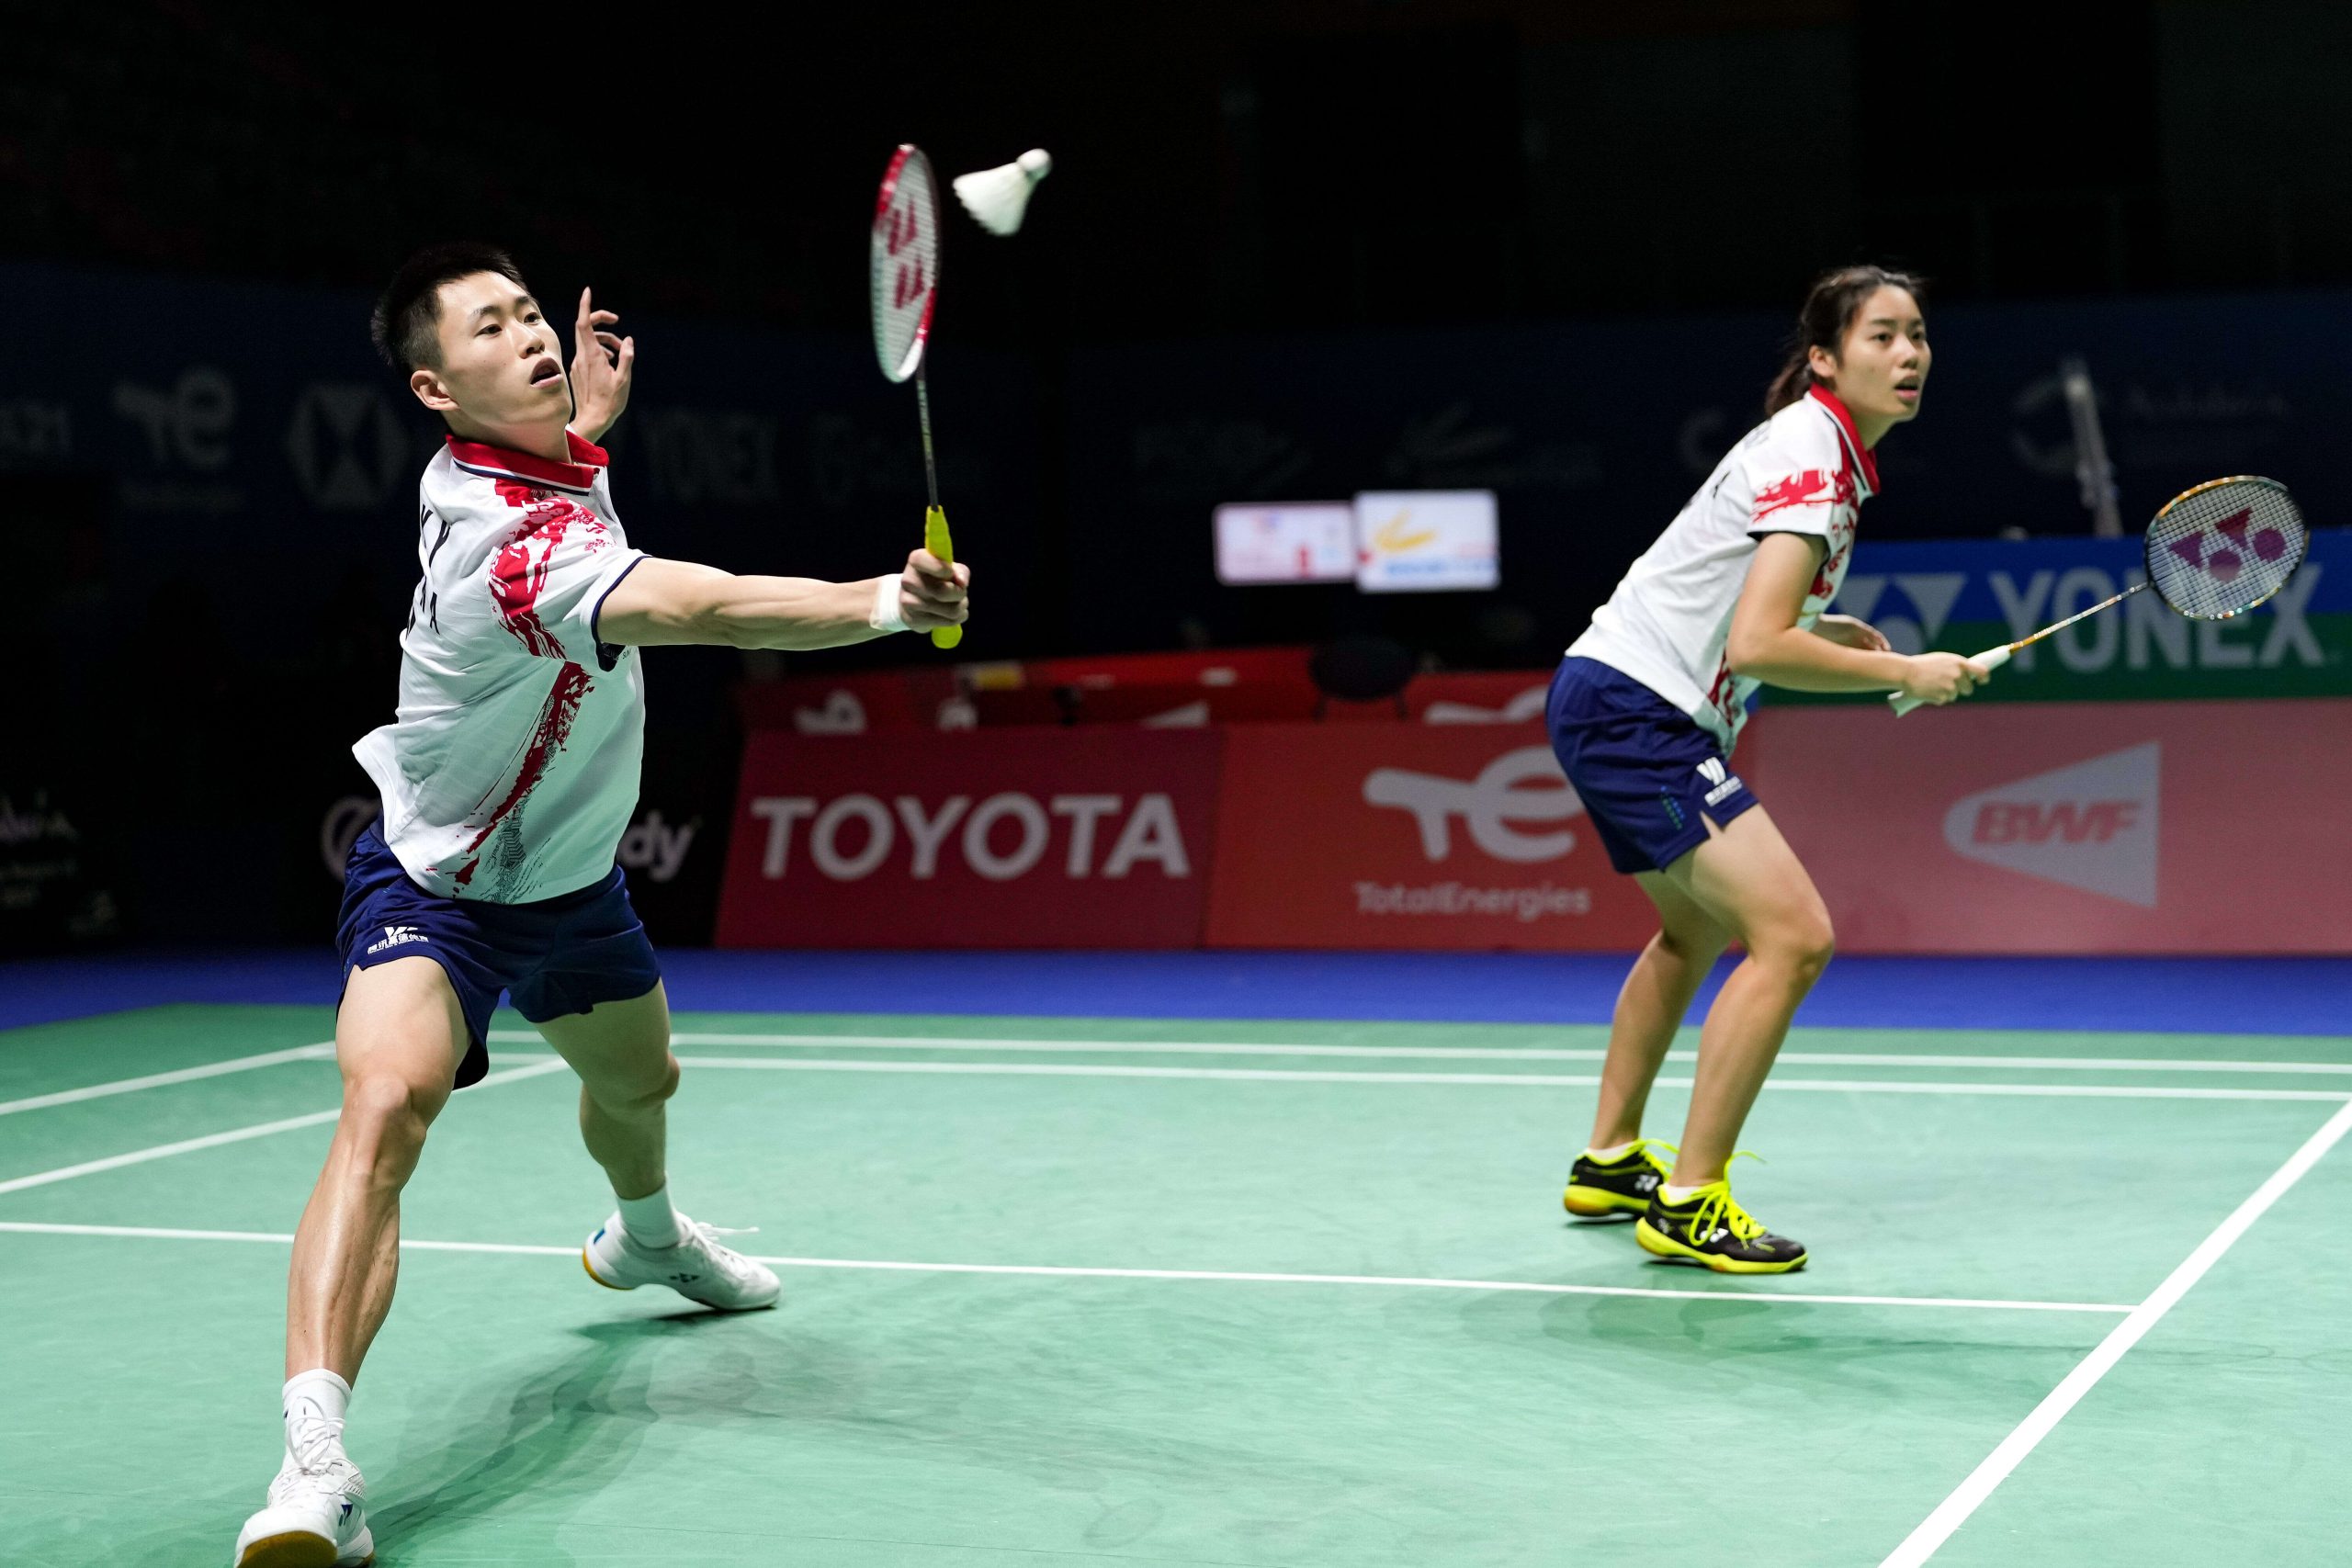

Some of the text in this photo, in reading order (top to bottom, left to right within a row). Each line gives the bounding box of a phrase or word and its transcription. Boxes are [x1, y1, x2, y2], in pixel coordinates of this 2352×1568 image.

[1988, 562, 2324, 672] YONEX
[750, 792, 1191, 881] TOYOTA
[1971, 800, 2143, 846] BWF
[1353, 881, 1592, 919] TotalEnergies
